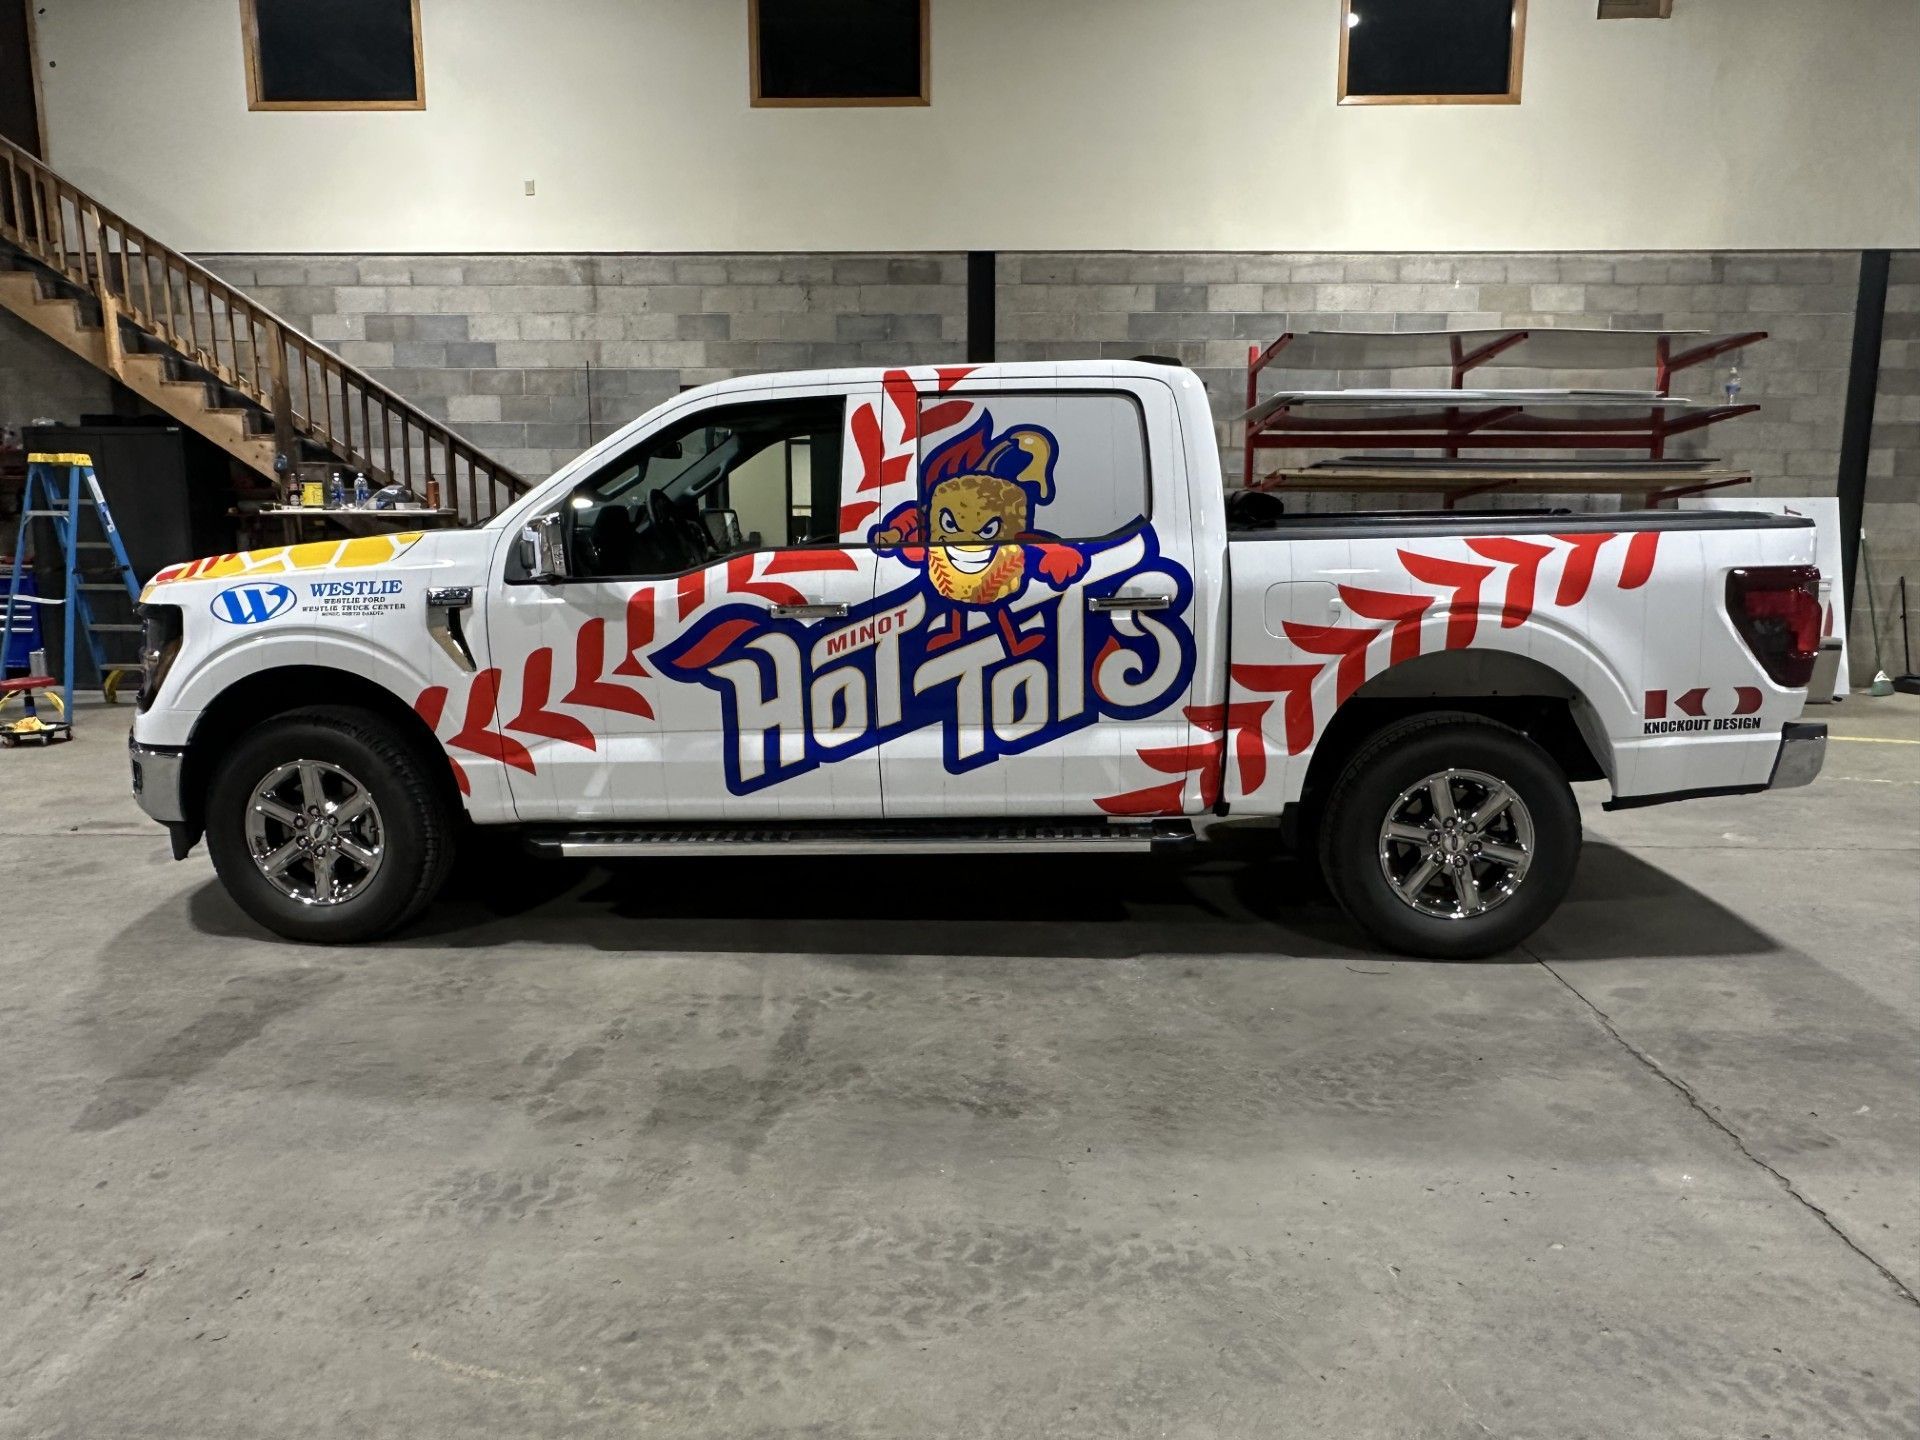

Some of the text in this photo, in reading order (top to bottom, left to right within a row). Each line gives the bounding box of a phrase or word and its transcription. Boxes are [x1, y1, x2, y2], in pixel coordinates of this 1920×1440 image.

[310, 580, 403, 597] WESTLIE
[219, 583, 291, 624] W
[362, 596, 386, 604] FORD
[372, 603, 406, 611] CENTER
[827, 608, 907, 656] MINOT
[1644, 718, 1761, 734] KNOCKOUT DESIGN
